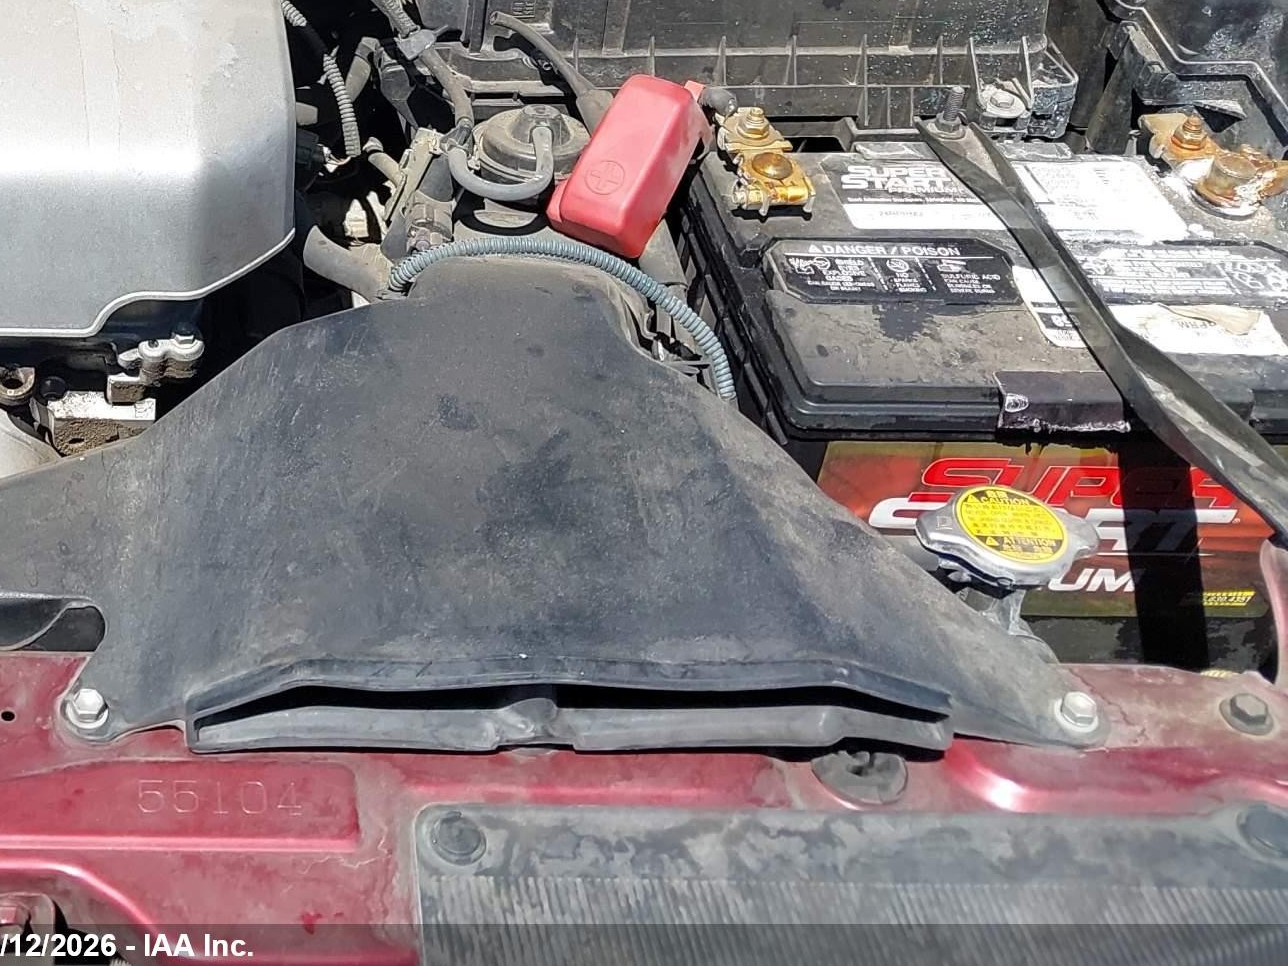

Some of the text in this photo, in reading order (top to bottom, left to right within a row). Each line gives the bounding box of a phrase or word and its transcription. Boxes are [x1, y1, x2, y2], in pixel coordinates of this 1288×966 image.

[848, 165, 948, 179] SUPER
[841, 175, 953, 190] START
[822, 245, 887, 254] DANGER
[901, 246, 961, 256] POISON
[980, 496, 1030, 506] CAUTION
[1003, 536, 1057, 547] ATTENTION
[137, 779, 303, 816] 55104
